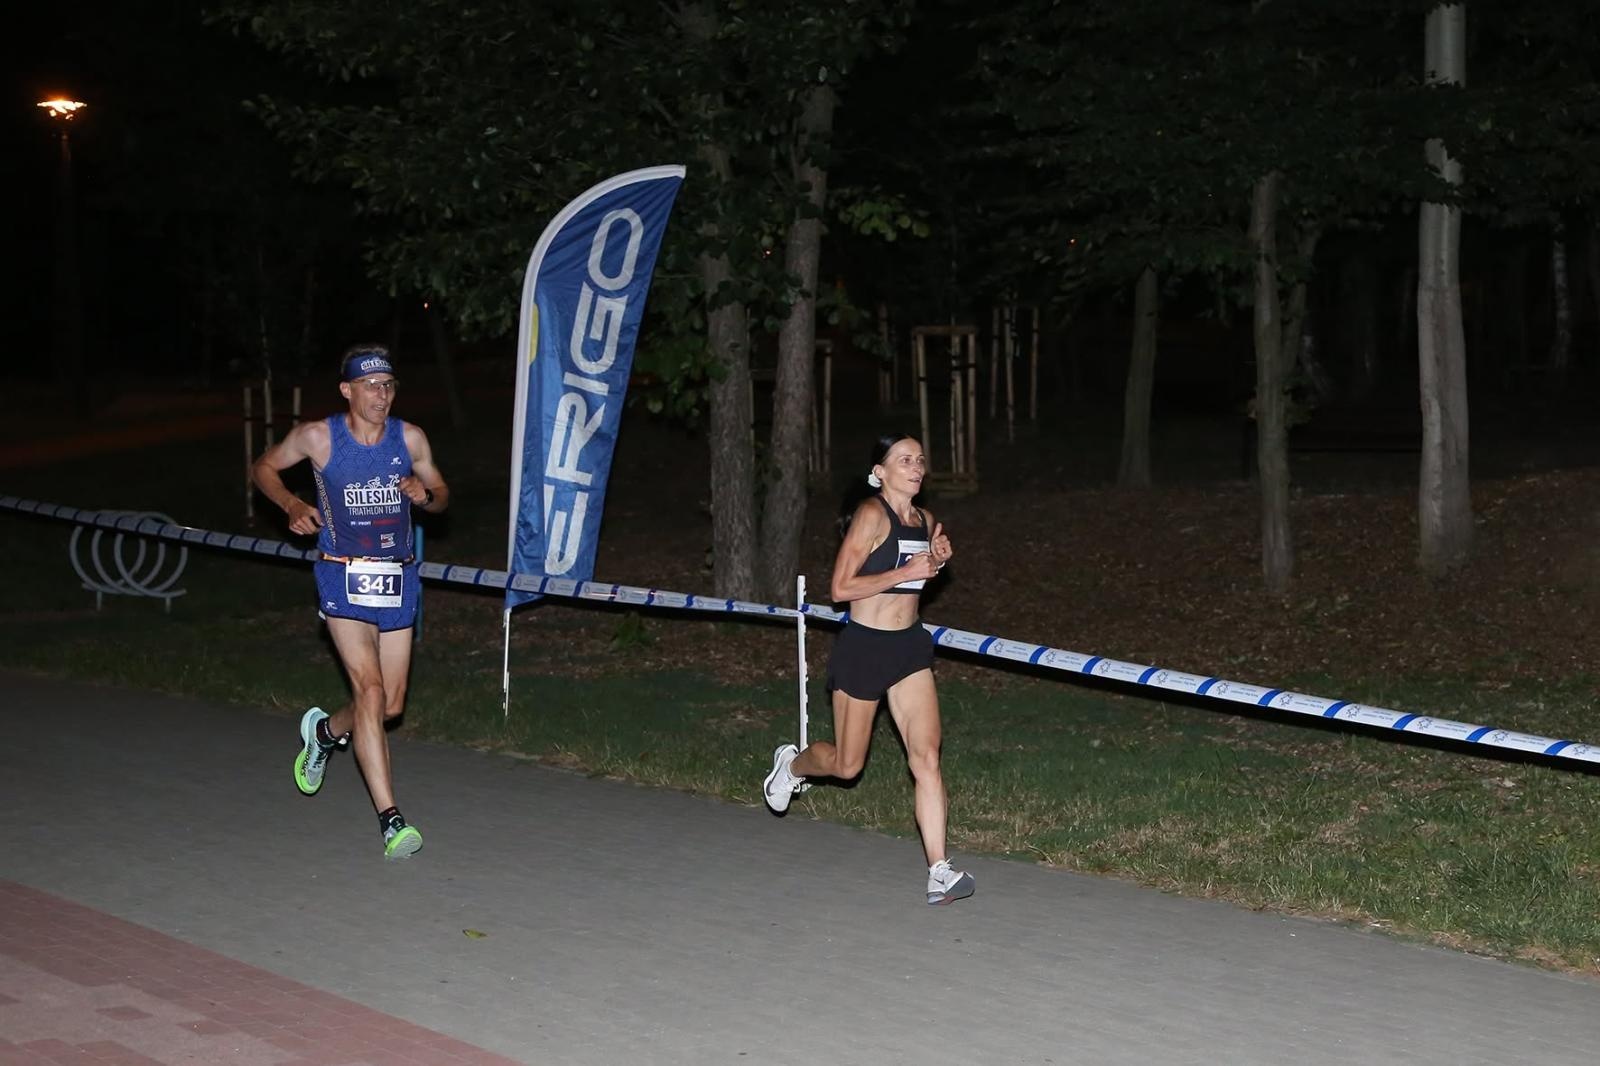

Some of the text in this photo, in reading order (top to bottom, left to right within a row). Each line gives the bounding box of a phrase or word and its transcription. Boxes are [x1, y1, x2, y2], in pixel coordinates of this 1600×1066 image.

[346, 488, 401, 505] SILESIAN
[348, 505, 401, 516] TRIATHLON TEAM
[357, 574, 395, 594] 341
